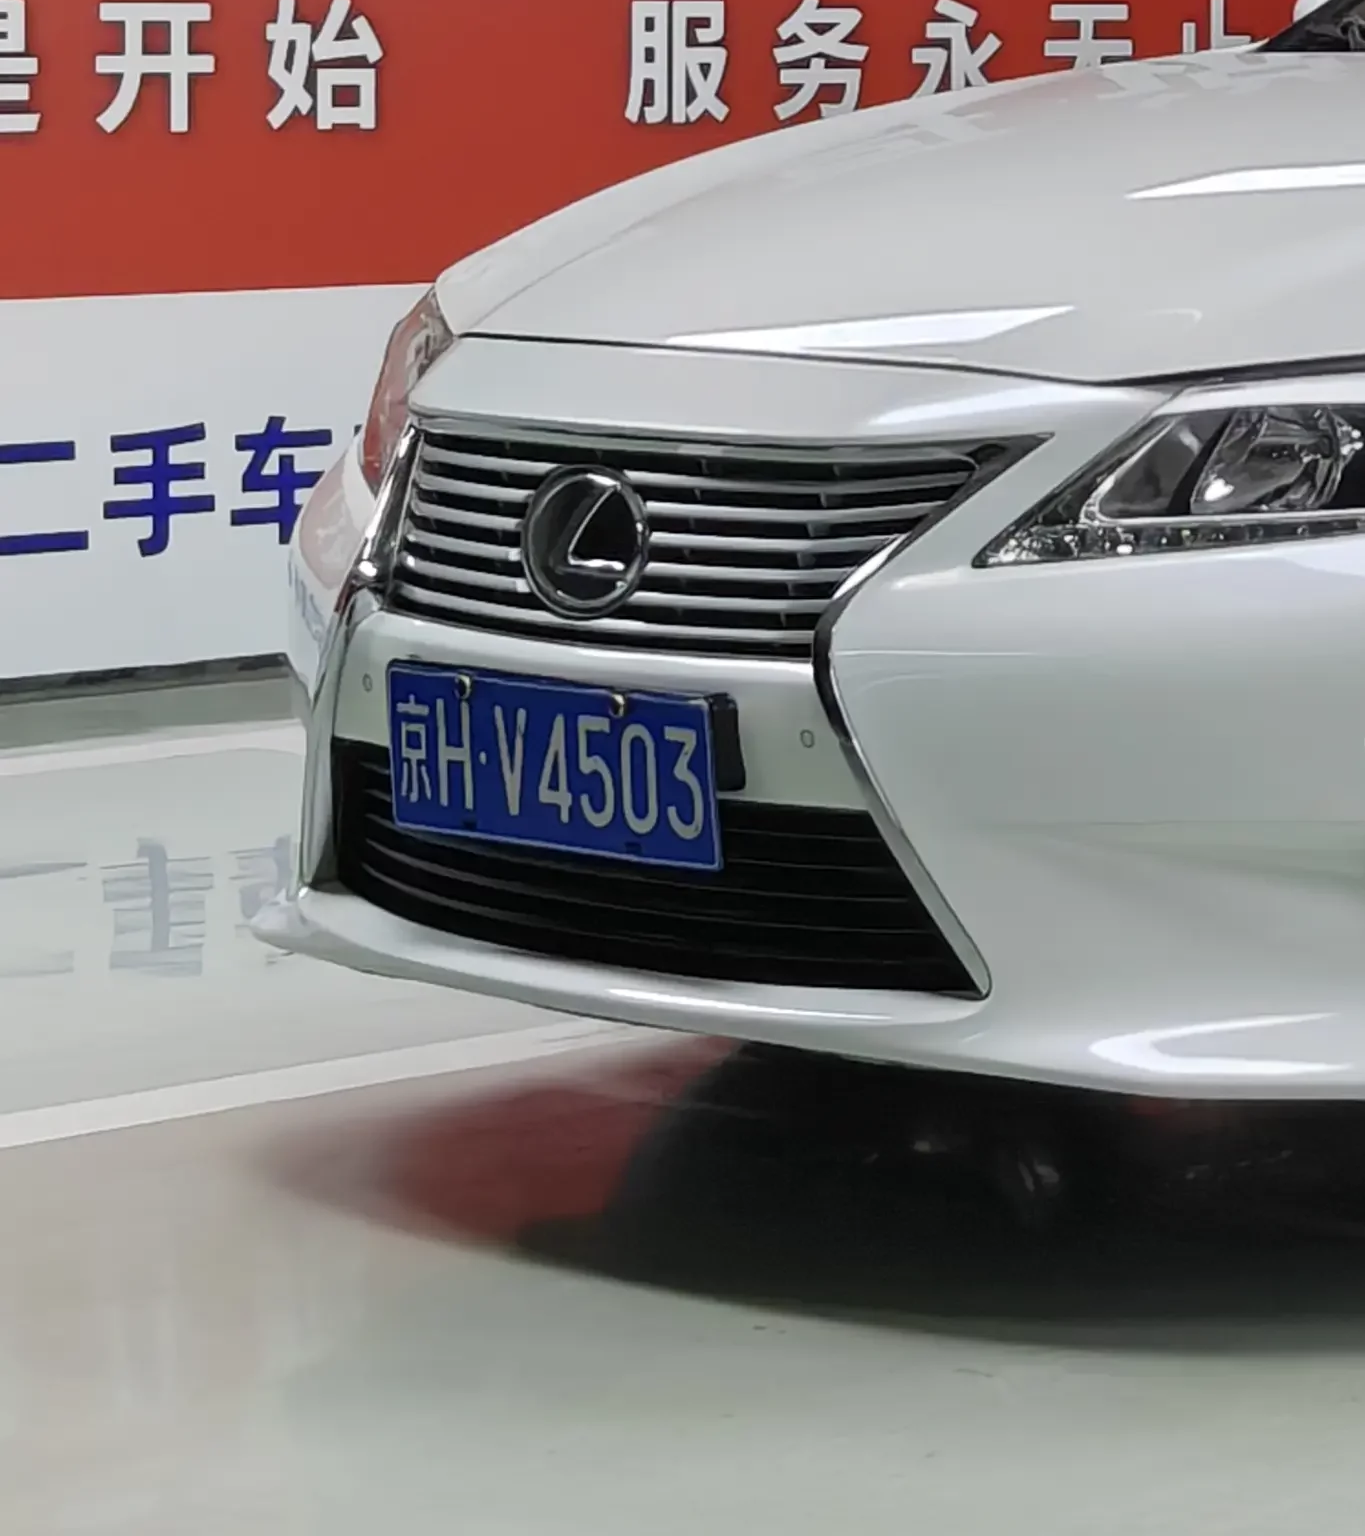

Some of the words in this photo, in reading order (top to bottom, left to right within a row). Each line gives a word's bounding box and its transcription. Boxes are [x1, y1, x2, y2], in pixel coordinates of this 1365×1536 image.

[0, 416, 363, 557] 二手车
[396, 694, 704, 840] 京H·V4503
